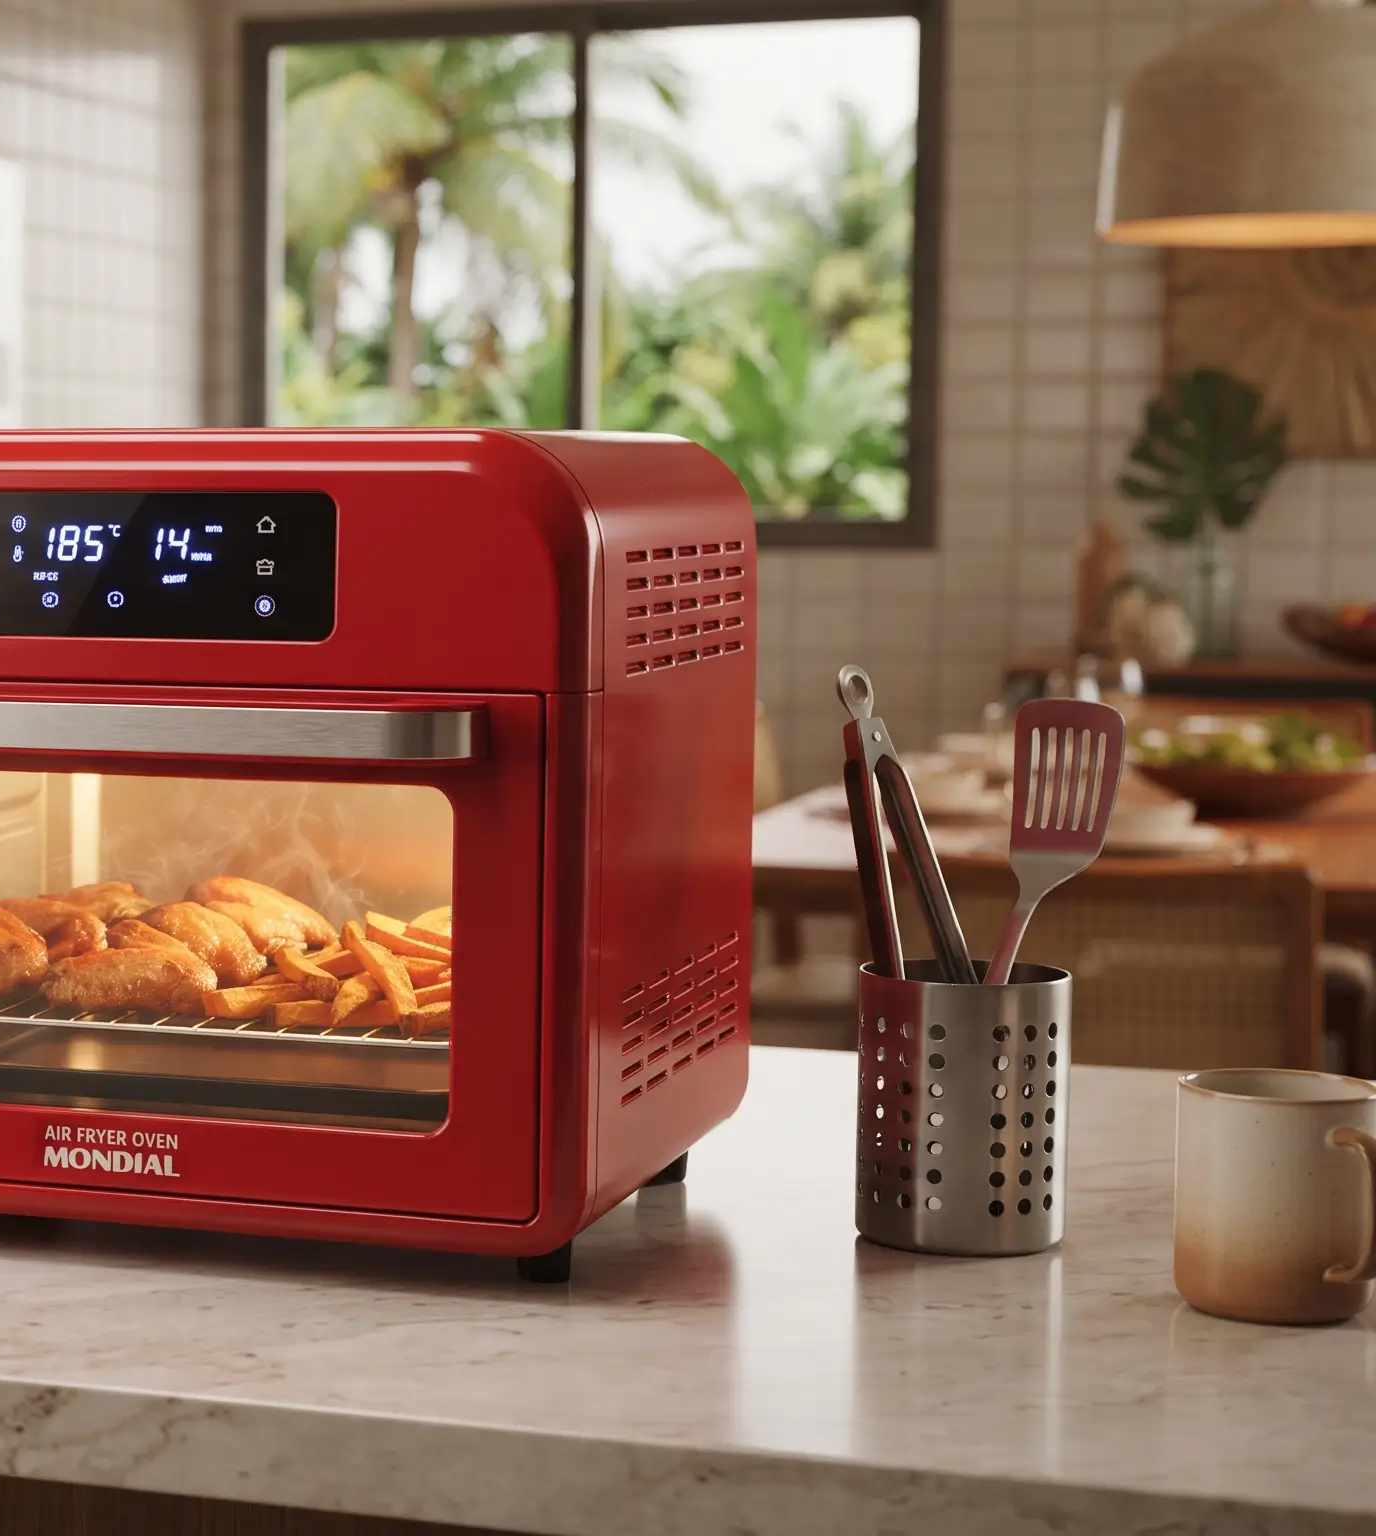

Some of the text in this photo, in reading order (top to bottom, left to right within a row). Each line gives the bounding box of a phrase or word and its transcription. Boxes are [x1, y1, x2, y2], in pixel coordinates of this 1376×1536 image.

[46, 524, 104, 562] 185
[154, 527, 191, 561] 14
[44, 1125, 179, 1150] AIR FRYER OVEN
[43, 1145, 181, 1178] MONDIAL
